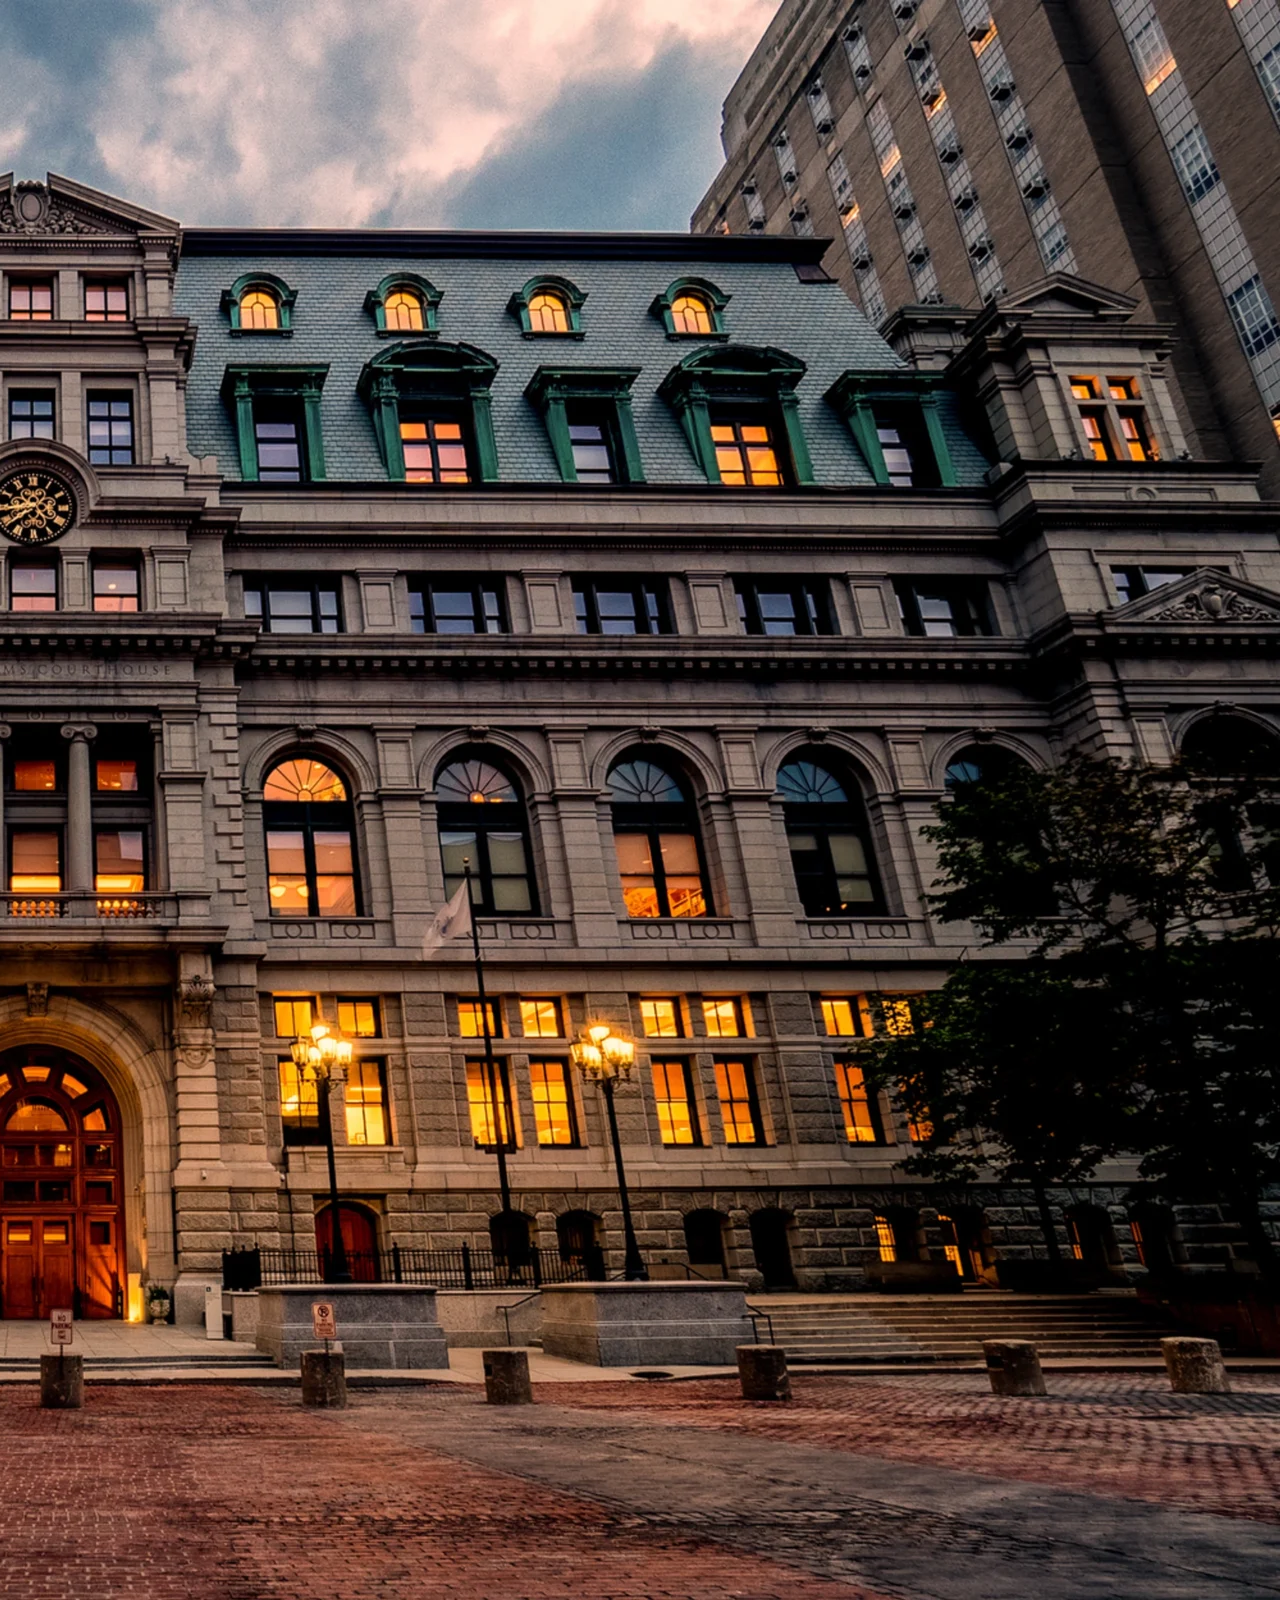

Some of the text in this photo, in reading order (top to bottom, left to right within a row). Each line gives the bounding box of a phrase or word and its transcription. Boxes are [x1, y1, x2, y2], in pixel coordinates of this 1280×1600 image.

[37, 664, 171, 676] COURTHOUSE
[57, 1314, 66, 1322] NO
[51, 1322, 72, 1330] PARKING
